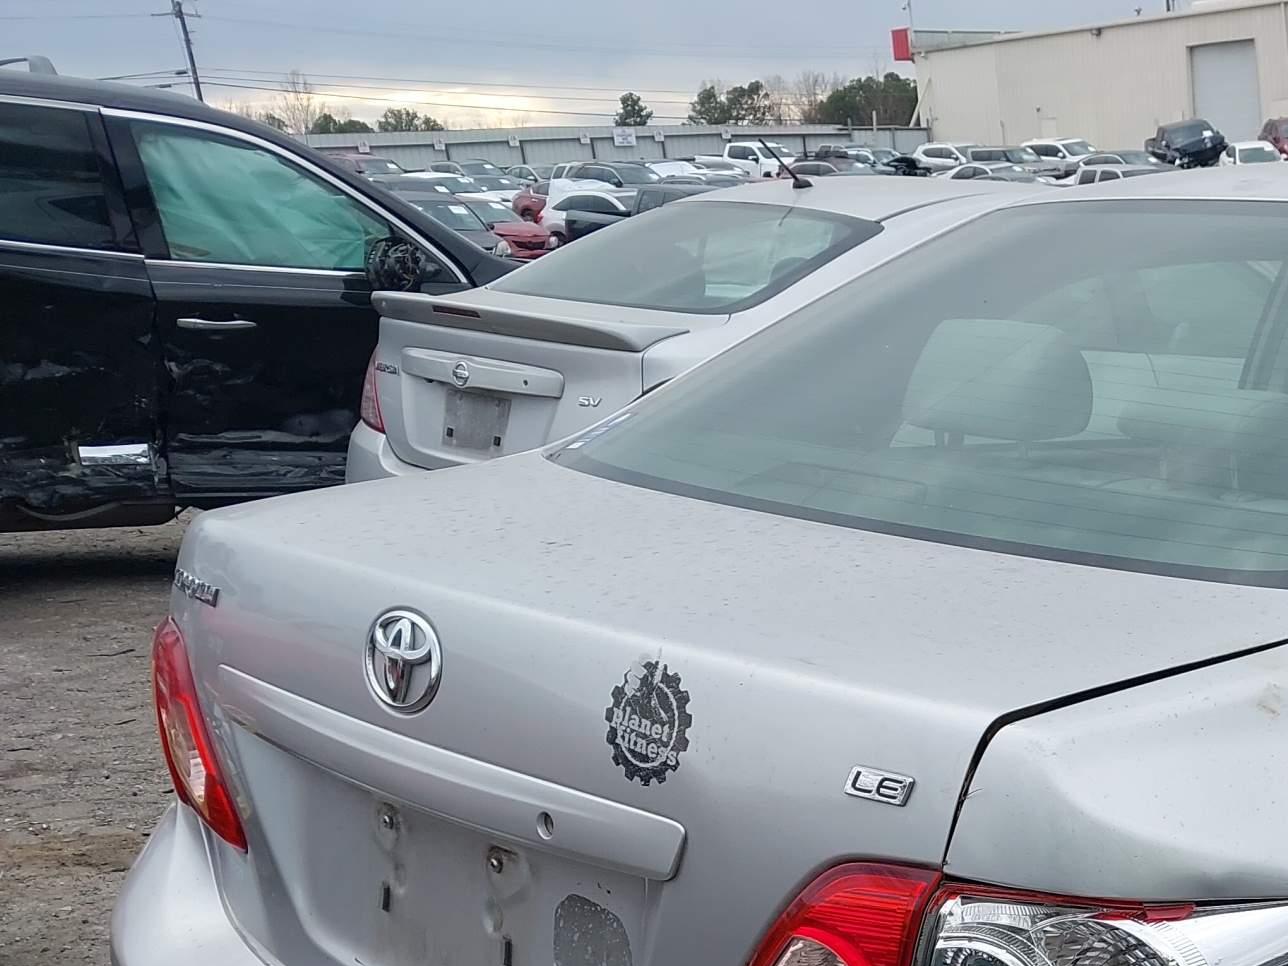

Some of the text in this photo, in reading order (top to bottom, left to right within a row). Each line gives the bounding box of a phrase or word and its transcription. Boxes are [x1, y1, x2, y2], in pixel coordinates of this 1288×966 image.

[578, 396, 602, 408] SV
[611, 706, 670, 742] planet
[615, 726, 678, 766] fitness
[850, 770, 904, 800] LE
